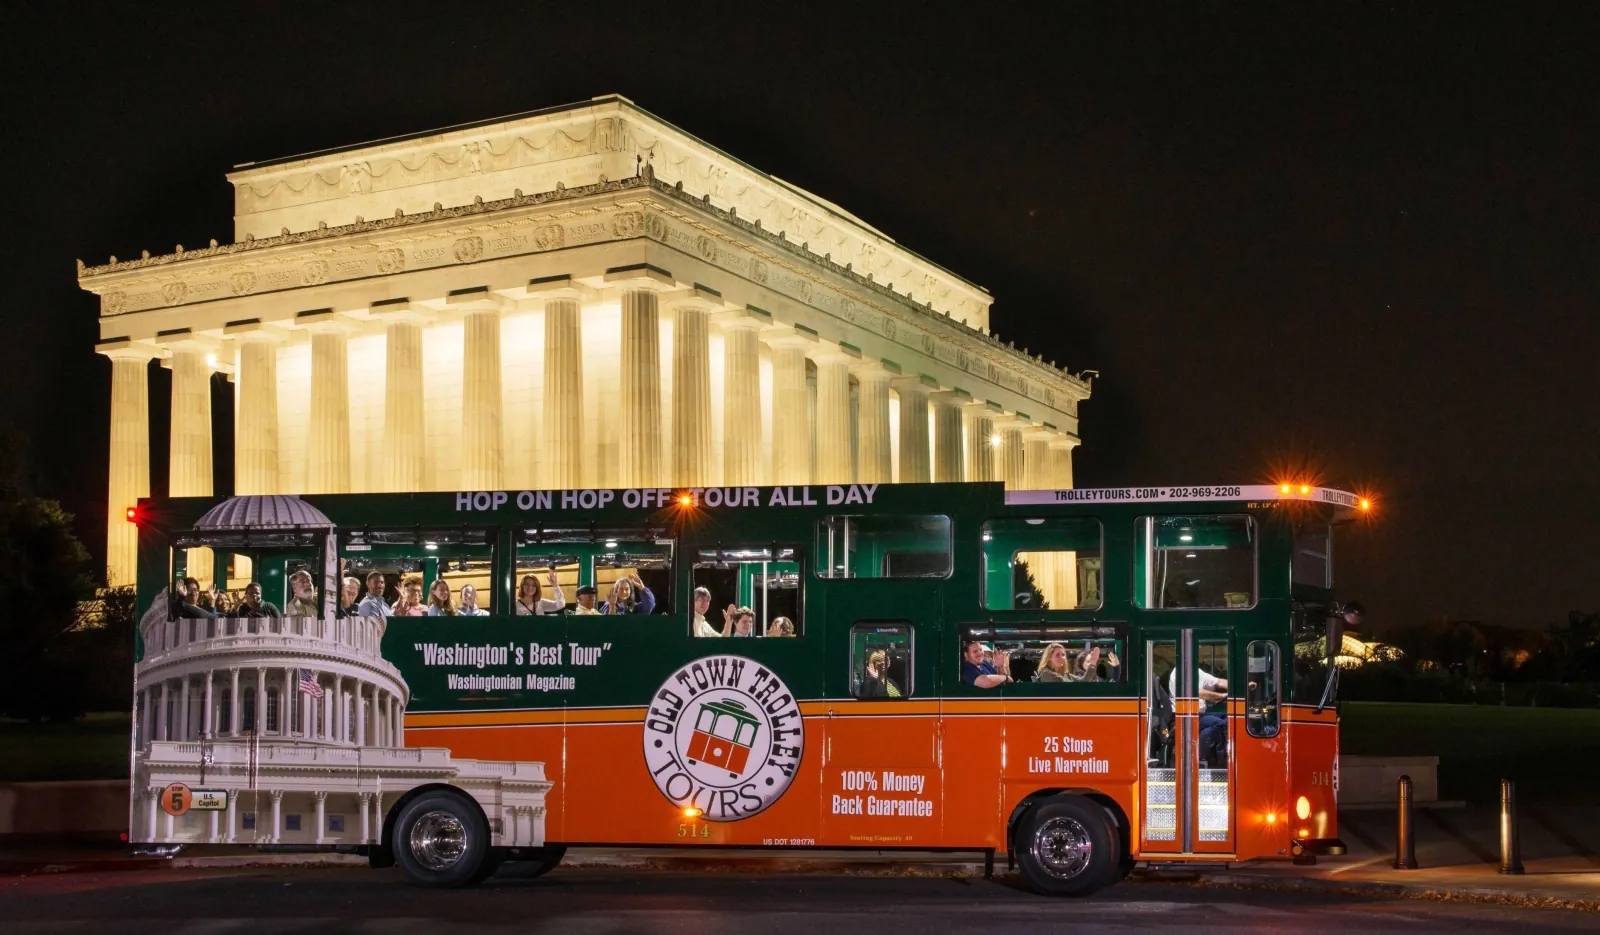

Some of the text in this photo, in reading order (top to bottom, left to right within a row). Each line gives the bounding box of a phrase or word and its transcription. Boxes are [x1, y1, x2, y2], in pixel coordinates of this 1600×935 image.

[455, 484, 879, 511] HOP ON HOP OFF TOUR ALL DAY
[1054, 486, 1241, 501] TROLLEYTOURS.COM 202-969-2206
[414, 642, 612, 668] "Washington's Best Tour"
[448, 673, 576, 692] Washingtonian Magazine
[647, 658, 801, 778] OLD TOWN TROLLEY
[1044, 736, 1093, 755] 25 Stops
[1028, 757, 1109, 773] Live Narration
[653, 750, 763, 818] TOURS
[840, 770, 925, 795] 100% Money
[1312, 771, 1330, 786] 514
[172, 793, 183, 811] 5
[832, 795, 933, 817] Back Guarantee
[677, 823, 711, 838] 514
